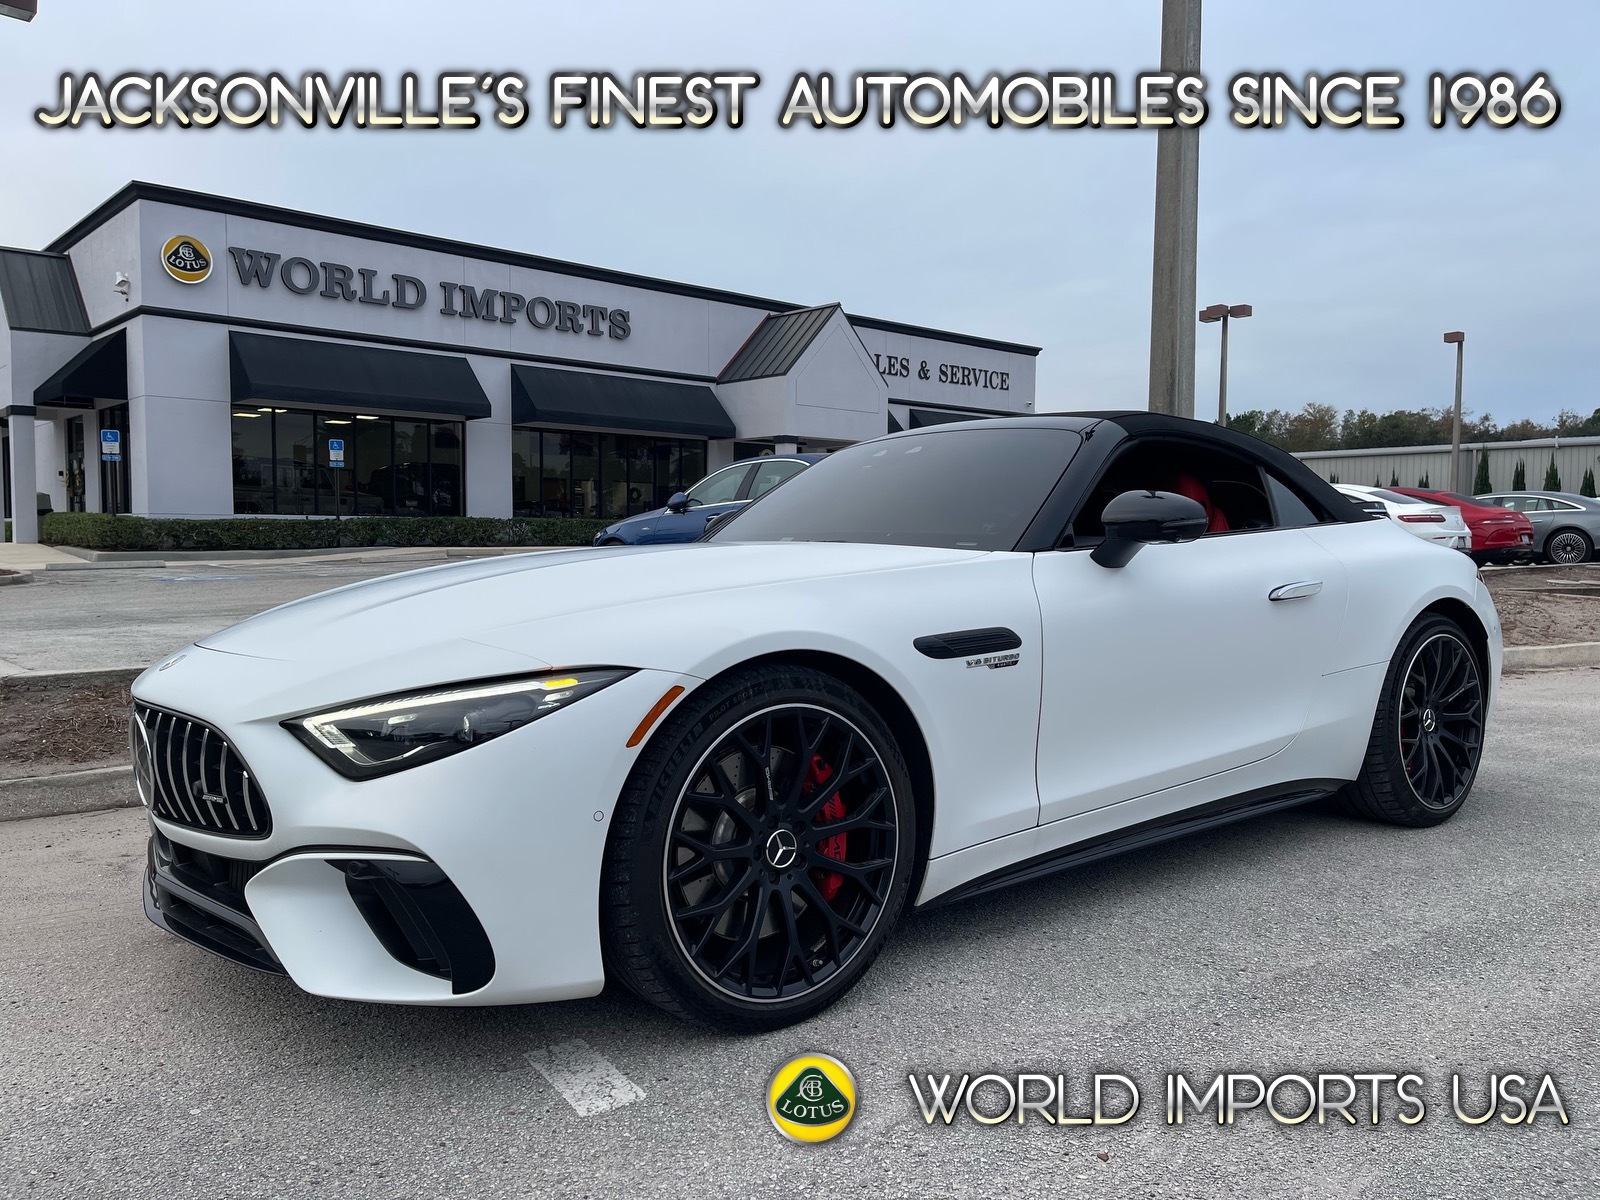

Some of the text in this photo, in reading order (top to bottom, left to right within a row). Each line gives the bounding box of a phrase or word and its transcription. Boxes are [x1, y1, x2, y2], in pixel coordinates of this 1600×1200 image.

[169, 255, 207, 269] LOTUS
[228, 246, 632, 340] WORLD IMPORTS
[917, 360, 931, 381] &
[938, 363, 1010, 391] SERVICE
[647, 721, 704, 820] MICHELIN
[708, 701, 730, 721] PILOT
